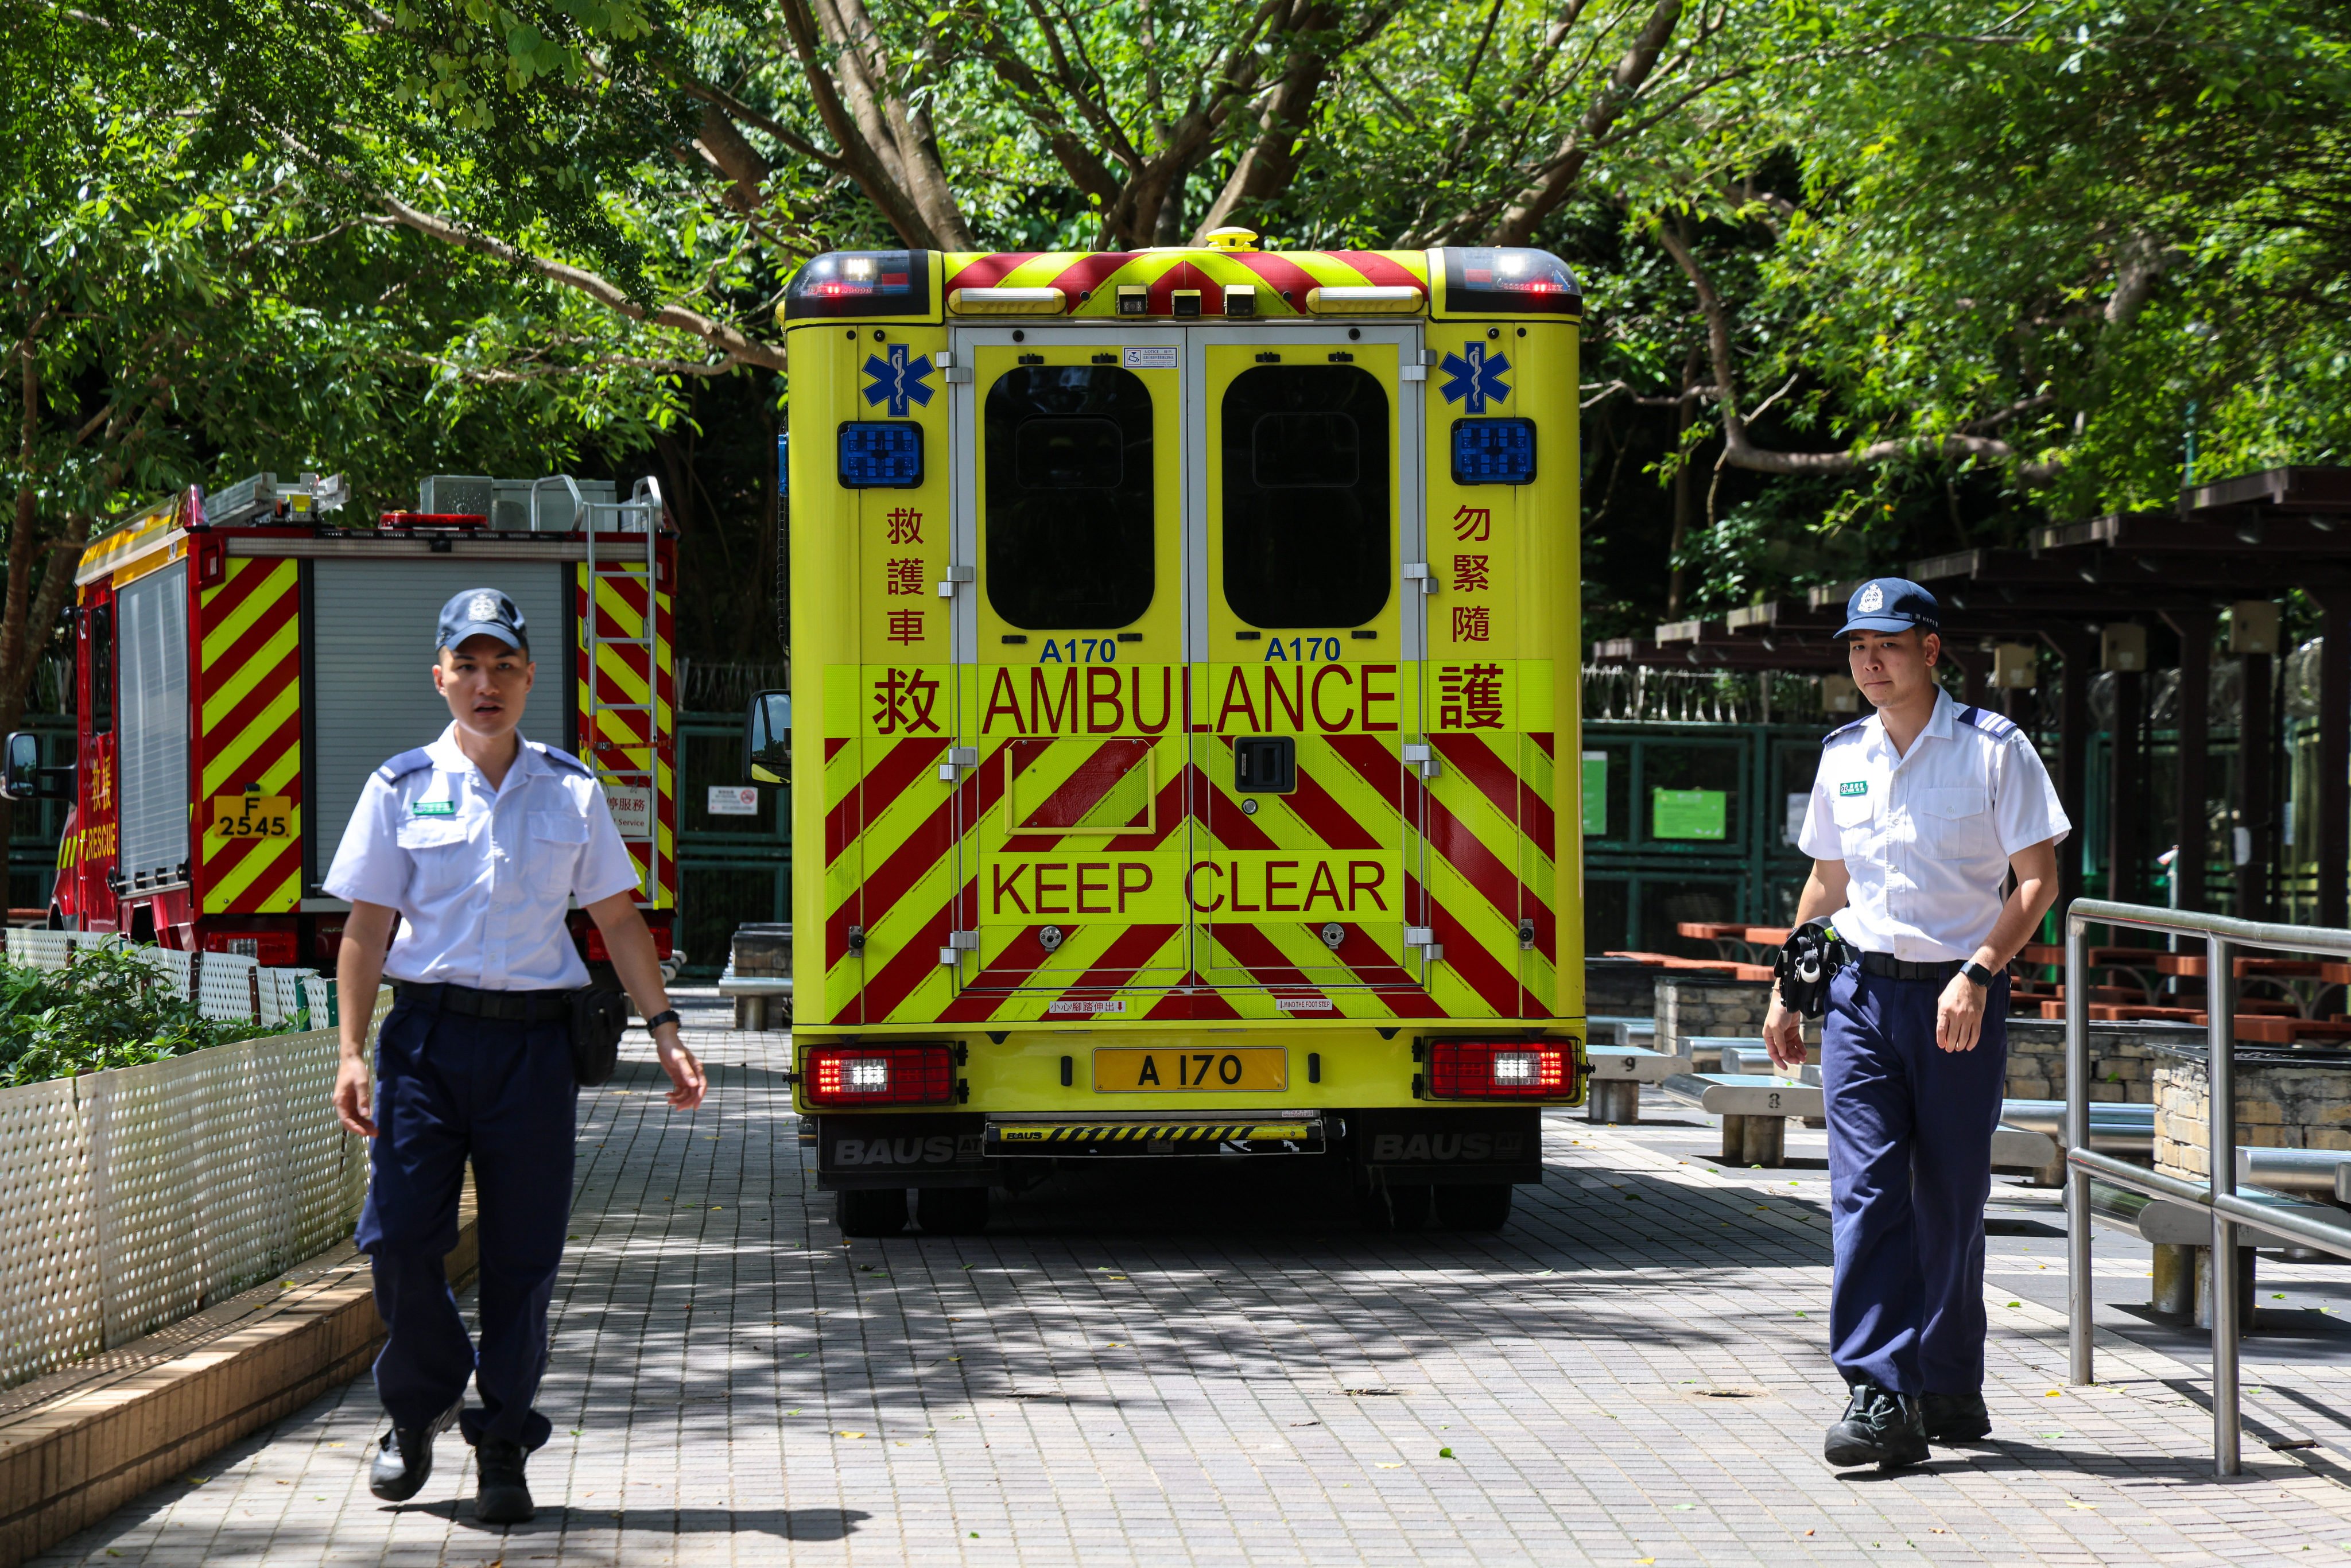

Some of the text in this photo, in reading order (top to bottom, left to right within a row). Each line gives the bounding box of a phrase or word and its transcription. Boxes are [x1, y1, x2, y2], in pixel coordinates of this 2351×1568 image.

[886, 507, 925, 646] 救護車
[1452, 504, 1490, 643] 勿緊隨
[1039, 638, 1116, 663] A170
[1264, 637, 1341, 662] A170
[872, 668, 940, 735] 救
[982, 664, 1398, 735] AMBULANCE
[1438, 663, 1505, 729] 護
[245, 797, 261, 816] F
[219, 816, 286, 836] 2545
[618, 818, 645, 827] Service
[88, 822, 116, 860] RESCUE
[993, 863, 1153, 915] KEEP
[1185, 860, 1388, 913] CLEAR
[1050, 1002, 1115, 1012] 小心腳踏伸出
[1138, 1054, 1242, 1086] A 170
[1625, 1057, 1636, 1072] 9
[1006, 1132, 1042, 1140] BAUS
[1372, 1132, 1493, 1161] BAUS
[834, 1136, 955, 1166] BAUS
